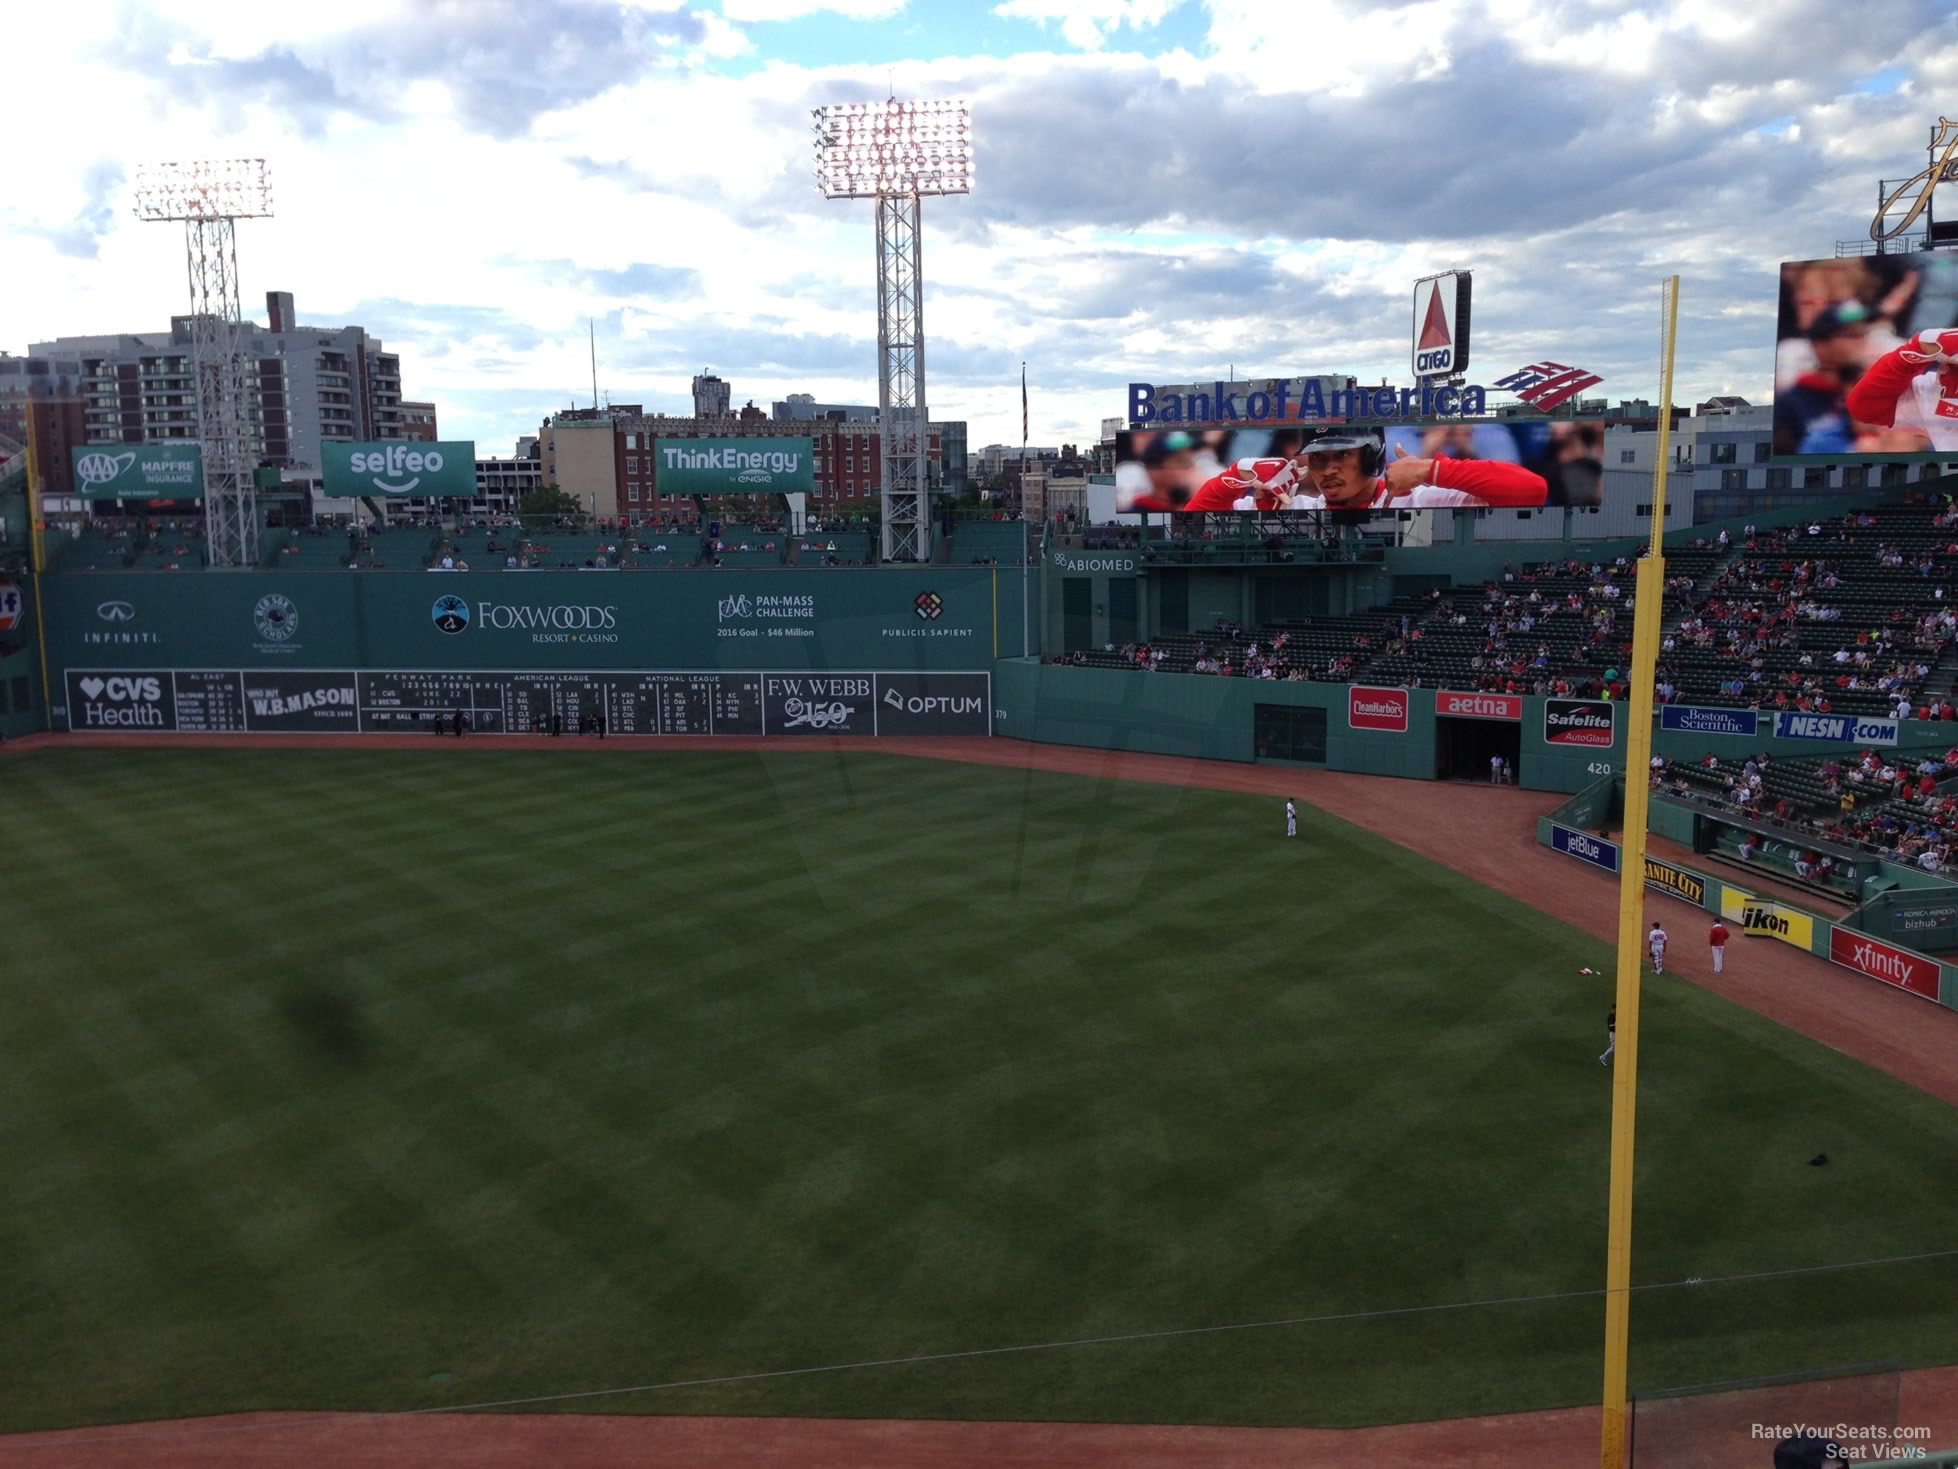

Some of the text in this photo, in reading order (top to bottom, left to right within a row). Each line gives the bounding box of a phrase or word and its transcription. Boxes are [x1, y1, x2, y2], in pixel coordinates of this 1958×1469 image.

[1417, 349, 1450, 372] CITGO
[1128, 375, 1486, 423] Bank of America
[82, 454, 113, 481] AAA
[142, 461, 194, 472] MAPFRE
[350, 446, 444, 476] selfeo
[664, 448, 798, 473] ThinkEnergy
[146, 475, 192, 483] INSURANCE
[1067, 559, 1134, 572] ABIOMED
[756, 596, 814, 606] PAN-MASS
[477, 602, 616, 629] FOXWOODS
[756, 608, 814, 618] CHALLENGE
[84, 632, 158, 643] INFINITI
[532, 634, 618, 643] RESORT CASINO
[717, 628, 814, 638] 2016 Goal $46 Million
[106, 676, 161, 701] CVS
[808, 679, 870, 696] WEBB
[84, 702, 164, 726] Health
[908, 696, 982, 714] OPTUM
[1354, 700, 1403, 718] CleanHarbors
[1448, 697, 1507, 716] aetna
[804, 701, 847, 728] 150
[996, 709, 1007, 720] 379
[1547, 713, 1611, 728] Safelite
[1680, 715, 1743, 732] Scientific
[1689, 709, 1728, 722] Boston
[1790, 716, 1846, 738] NESN
[1565, 732, 1610, 744] AutoGlass
[1587, 763, 1610, 776] 420
[1568, 832, 1600, 859] jetBlue
[1644, 862, 1676, 886] ANITE
[1742, 907, 1789, 935] ikon
[1905, 918, 1937, 929] bizhub
[1854, 944, 1913, 986] xfinity
